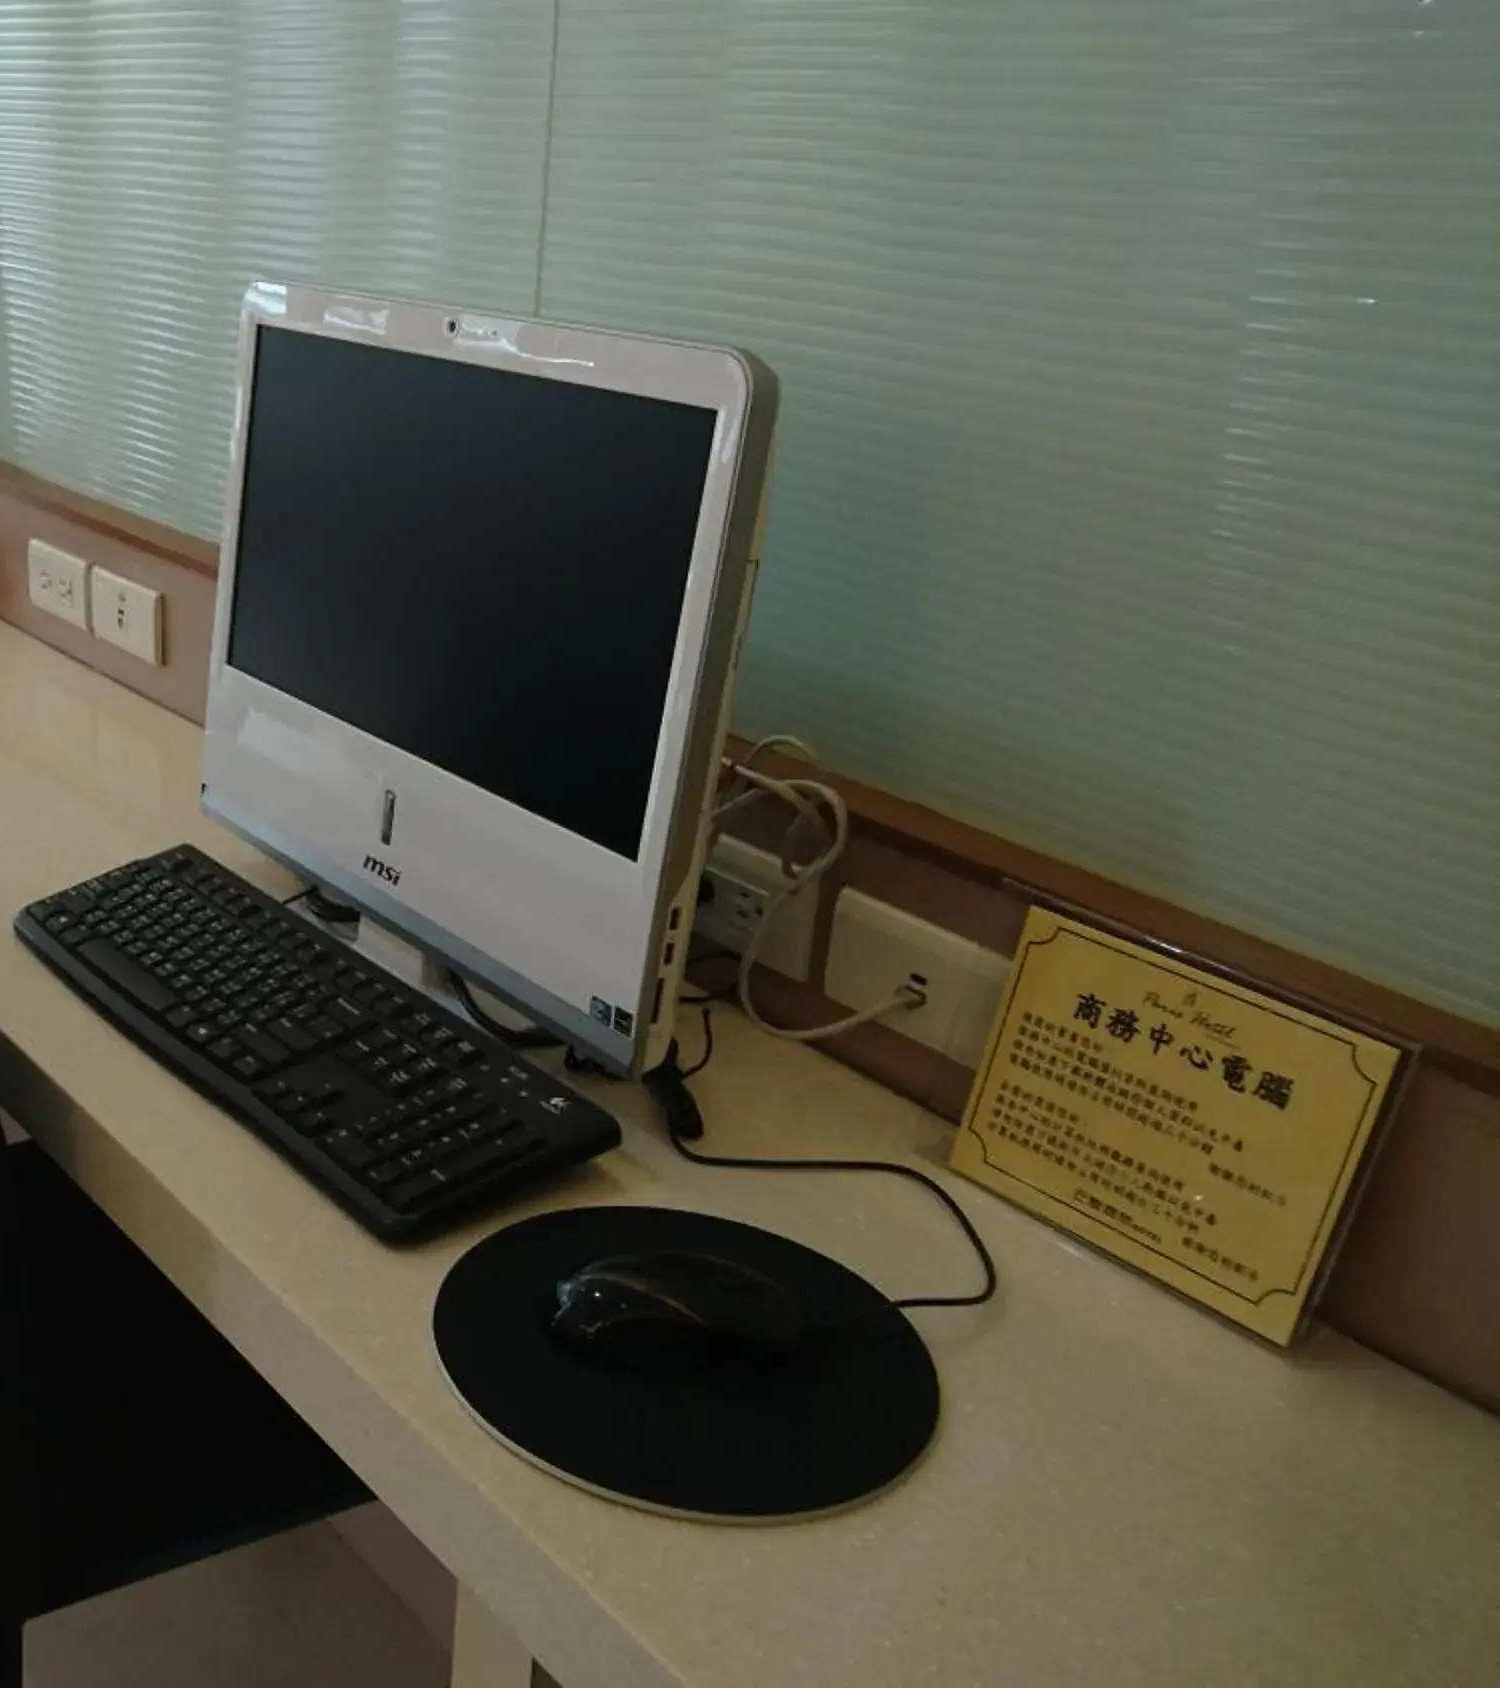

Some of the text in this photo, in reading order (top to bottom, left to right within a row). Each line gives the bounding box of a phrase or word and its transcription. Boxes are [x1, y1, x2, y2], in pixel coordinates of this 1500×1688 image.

[363, 854, 402, 886] msi
[1075, 992, 1295, 1110] 商務中心電腦
